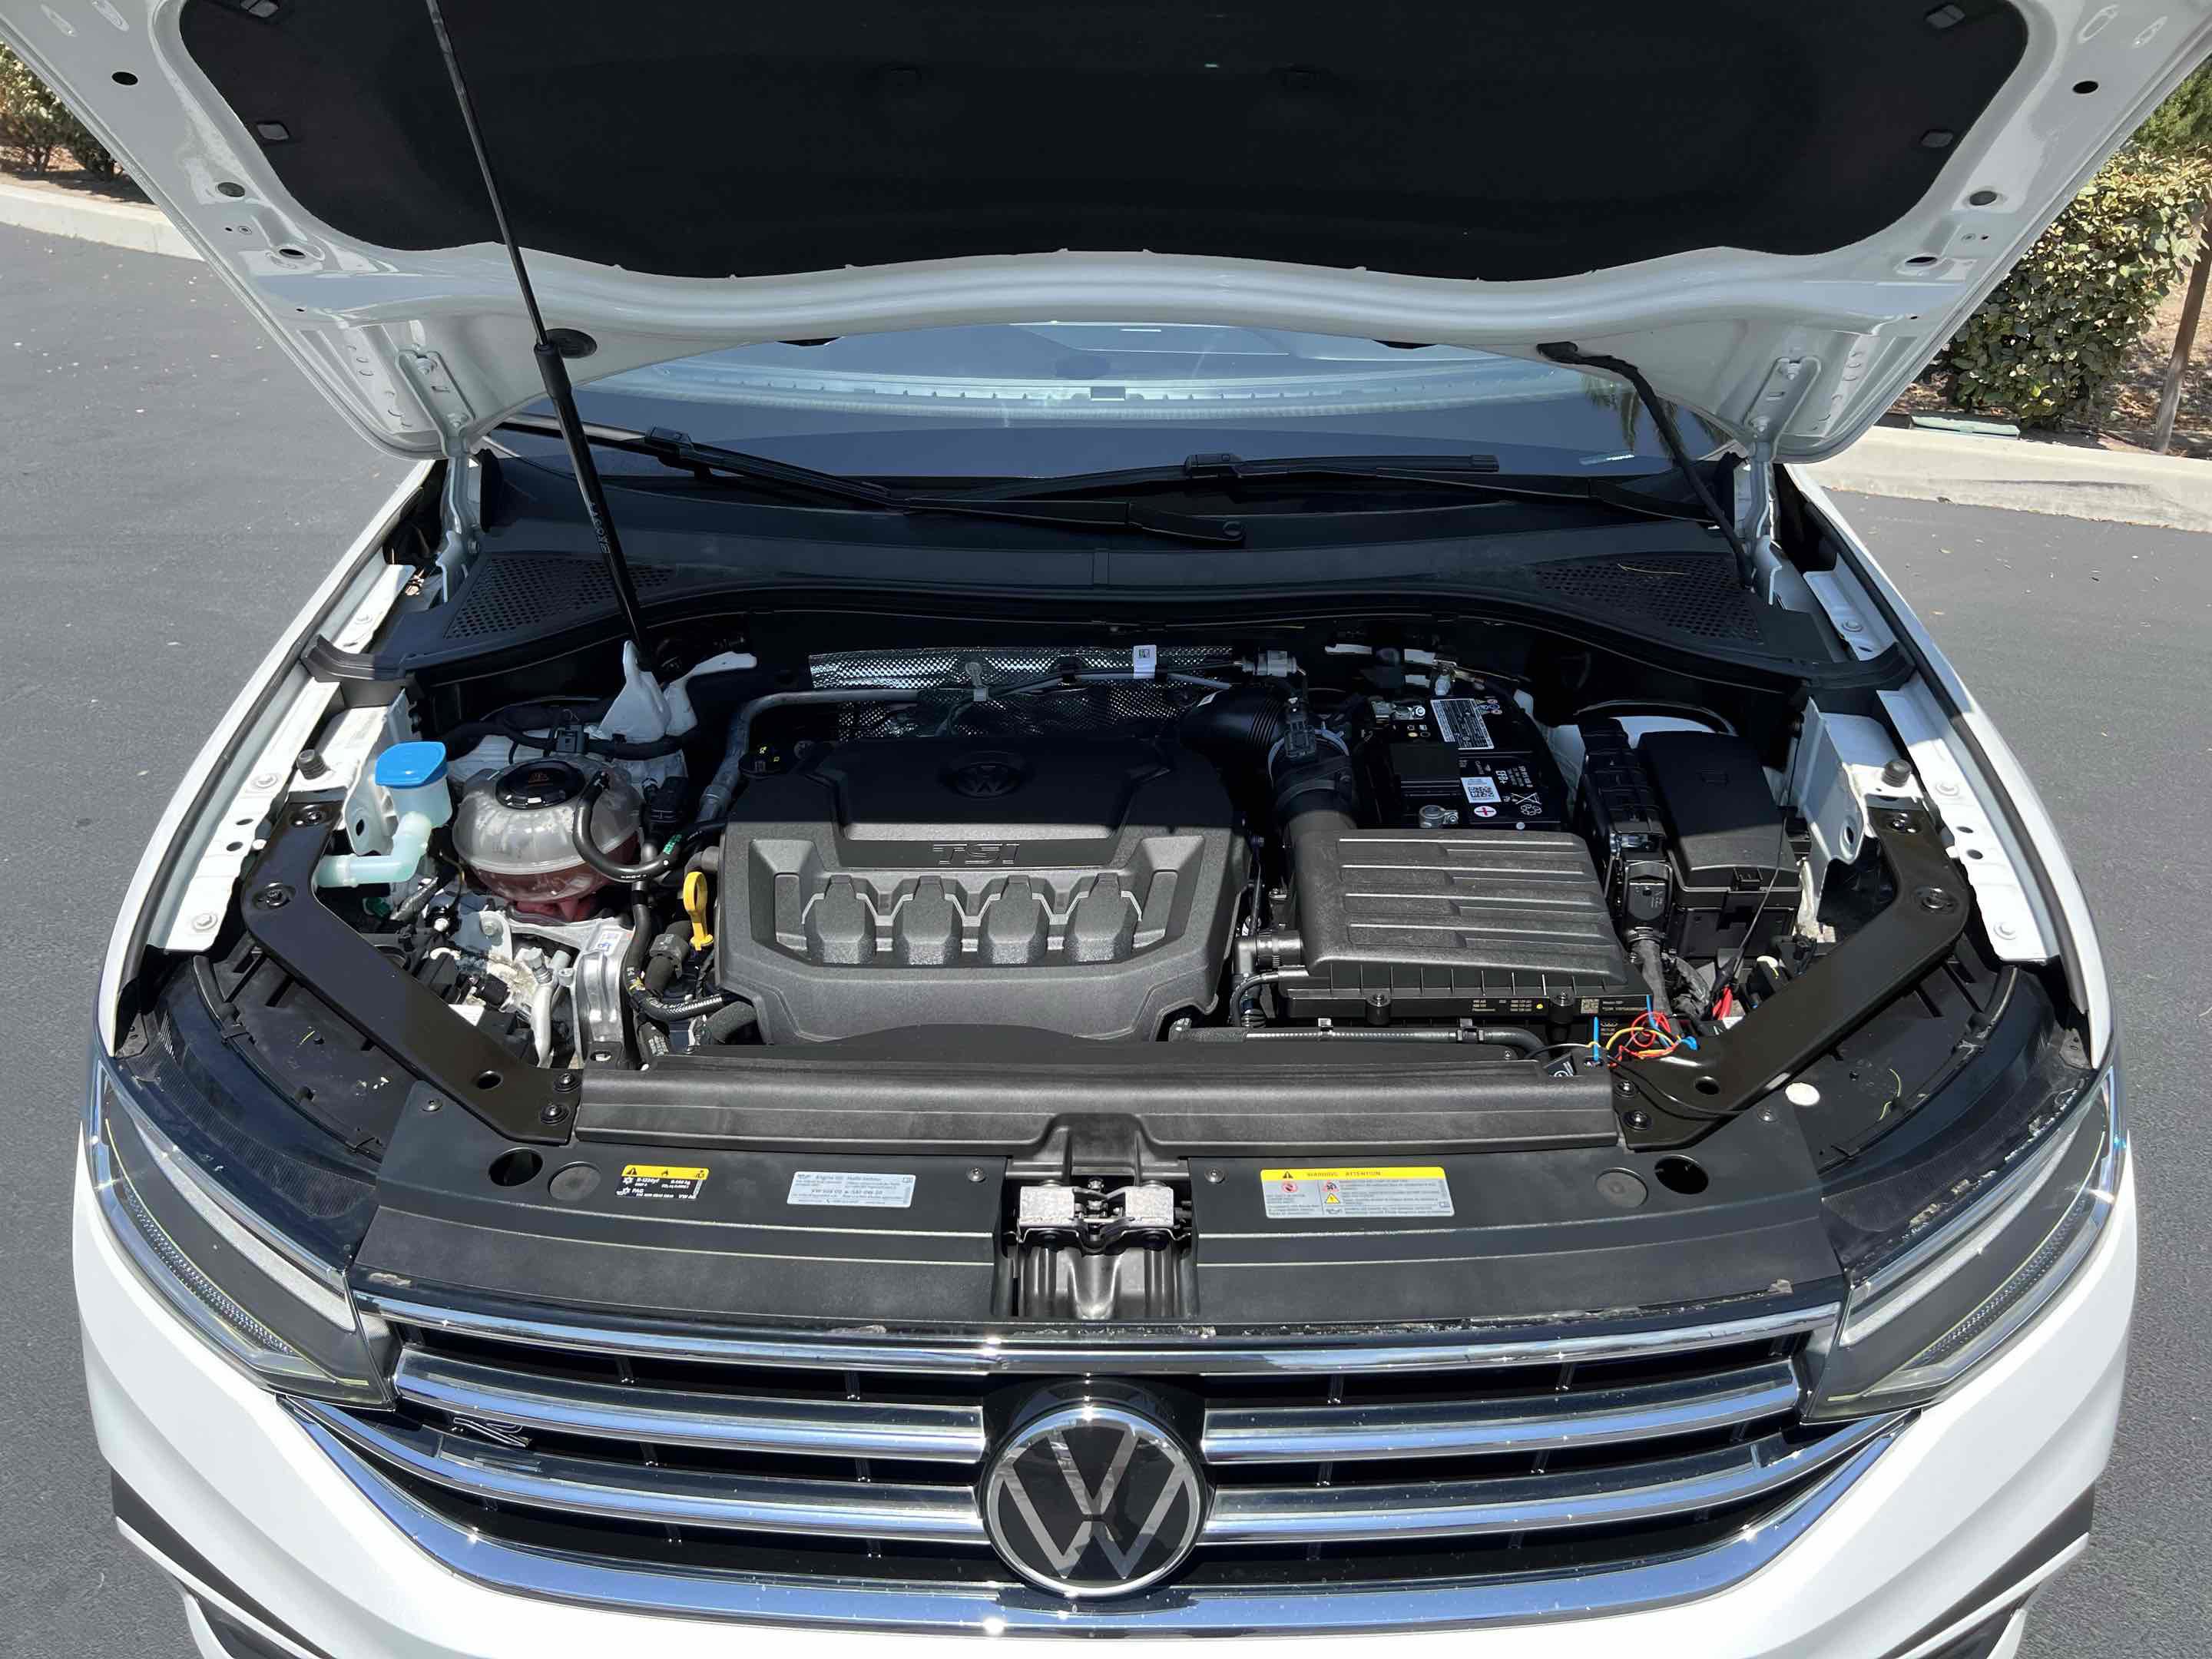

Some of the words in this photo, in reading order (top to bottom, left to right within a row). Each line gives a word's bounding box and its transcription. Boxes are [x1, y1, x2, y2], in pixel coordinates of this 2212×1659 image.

[1495, 770, 1509, 784] EFB+
[932, 843, 1020, 864] TSI
[997, 1419, 1190, 1581] VW
